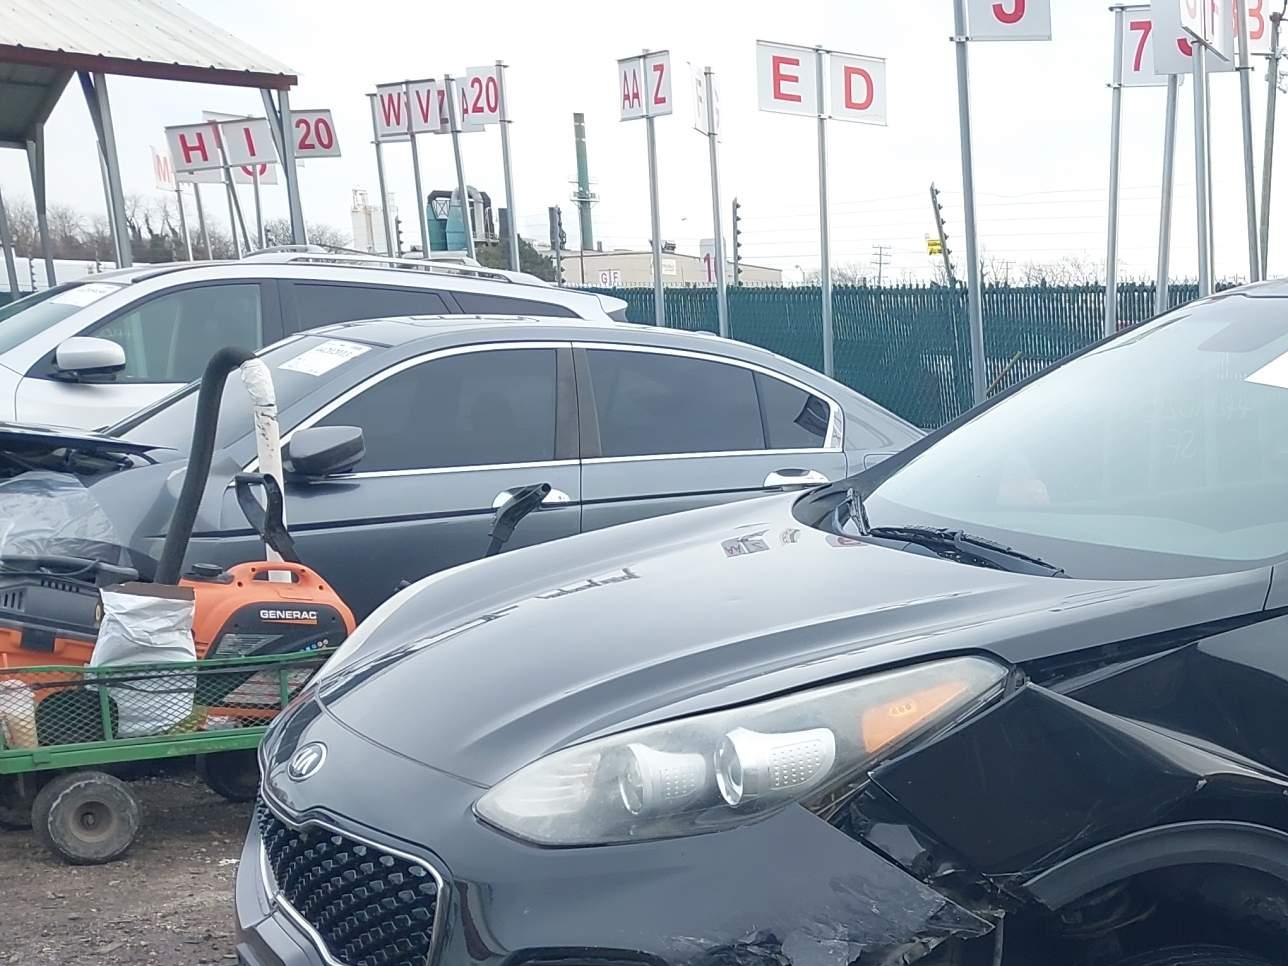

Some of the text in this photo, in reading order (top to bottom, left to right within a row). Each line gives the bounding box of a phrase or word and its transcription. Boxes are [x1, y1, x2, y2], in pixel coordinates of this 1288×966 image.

[470, 75, 499, 114] 20
[623, 68, 641, 110] AA
[652, 63, 667, 105] Z
[772, 55, 802, 103] E
[843, 64, 874, 111] D
[379, 91, 402, 128] W
[415, 88, 431, 124] V
[178, 131, 209, 164] H
[243, 127, 257, 158] I
[295, 117, 334, 151] 20
[600, 271, 608, 285] G
[613, 271, 619, 284] F
[259, 609, 318, 620] GENERAC
